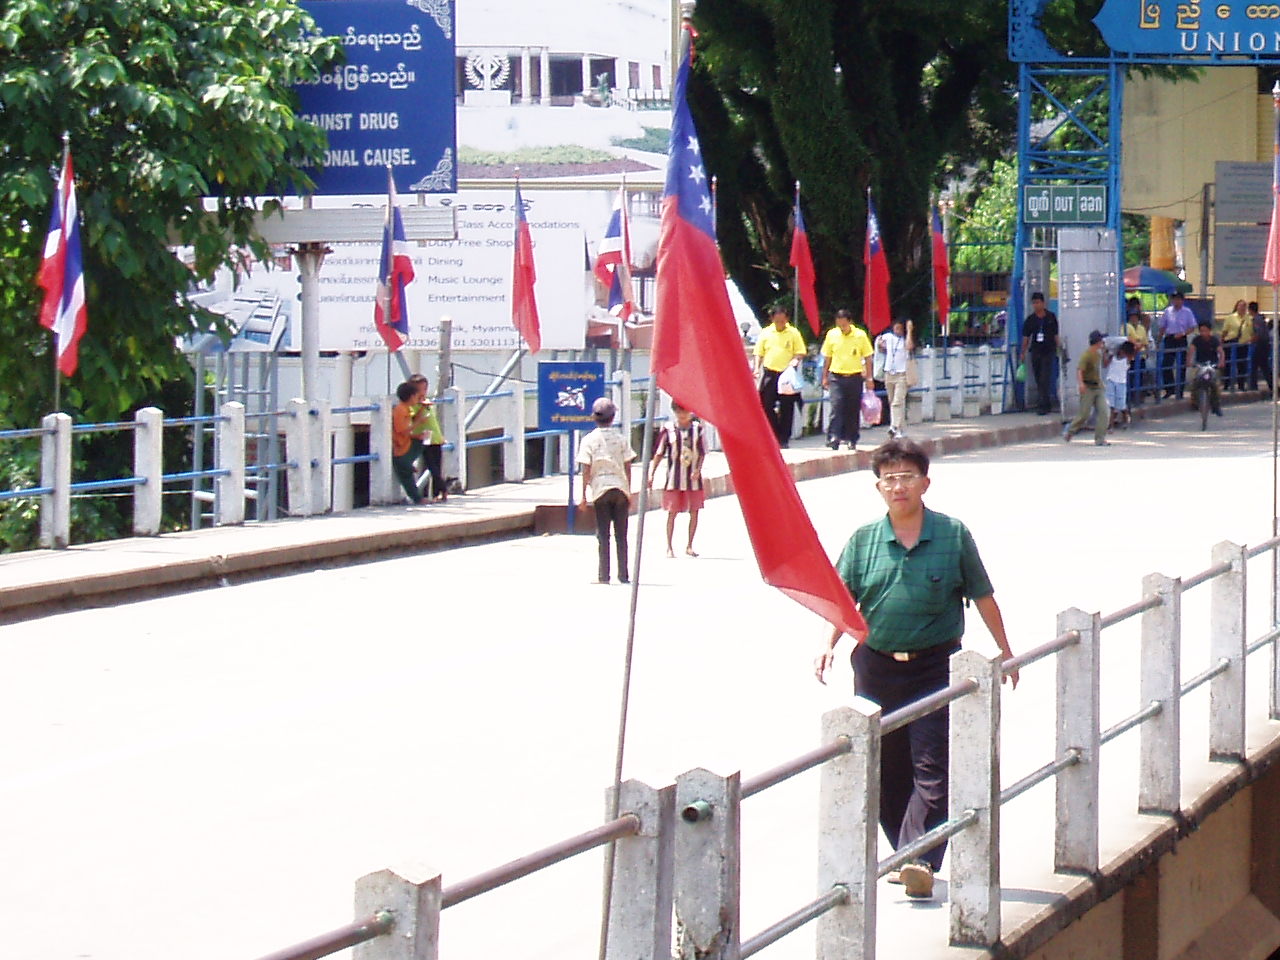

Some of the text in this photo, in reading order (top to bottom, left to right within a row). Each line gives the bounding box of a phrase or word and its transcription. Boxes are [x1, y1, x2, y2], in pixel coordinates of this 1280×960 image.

[359, 112, 399, 131] DRUG
[363, 147, 417, 167] CAUSE.
[1054, 195, 1075, 213] OUT
[457, 239, 483, 248] Free
[428, 256, 463, 267] Dining
[428, 276, 504, 287] Music Lounge
[428, 293, 506, 303] Entertainment
